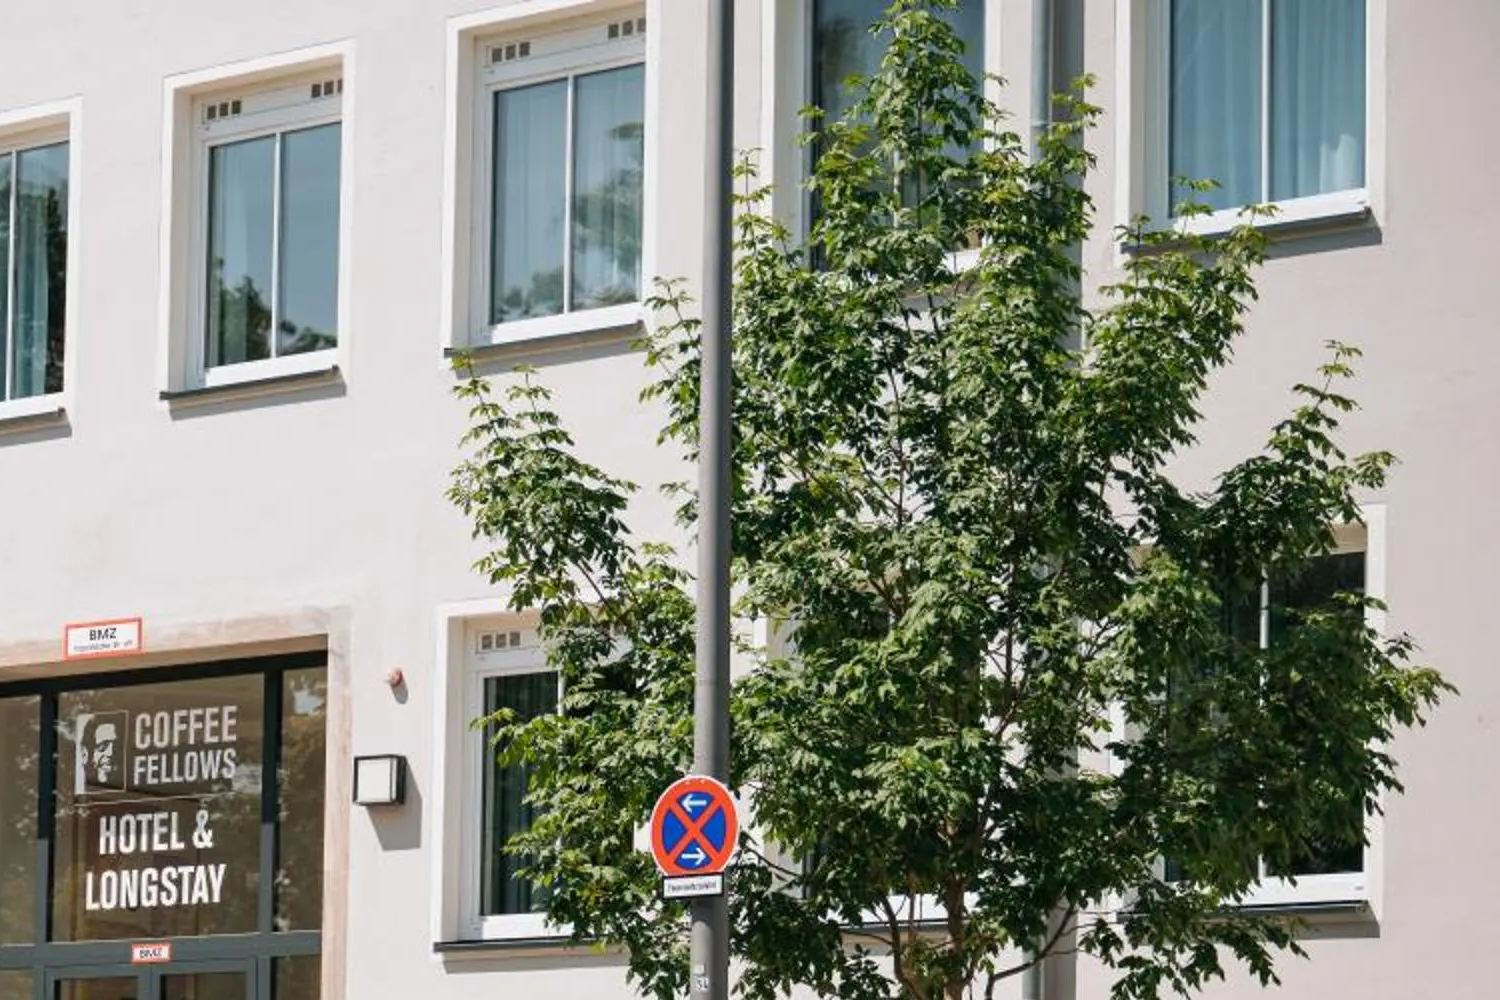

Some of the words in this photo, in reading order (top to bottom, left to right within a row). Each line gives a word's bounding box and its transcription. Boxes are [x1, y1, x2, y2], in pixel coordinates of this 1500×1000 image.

[89, 627, 117, 641] BMZ
[135, 706, 238, 749] COFFEE
[133, 748, 237, 785] FELLOWS
[99, 812, 185, 854] HOTEL
[192, 809, 214, 848] &
[85, 863, 227, 911] LONGSTAY
